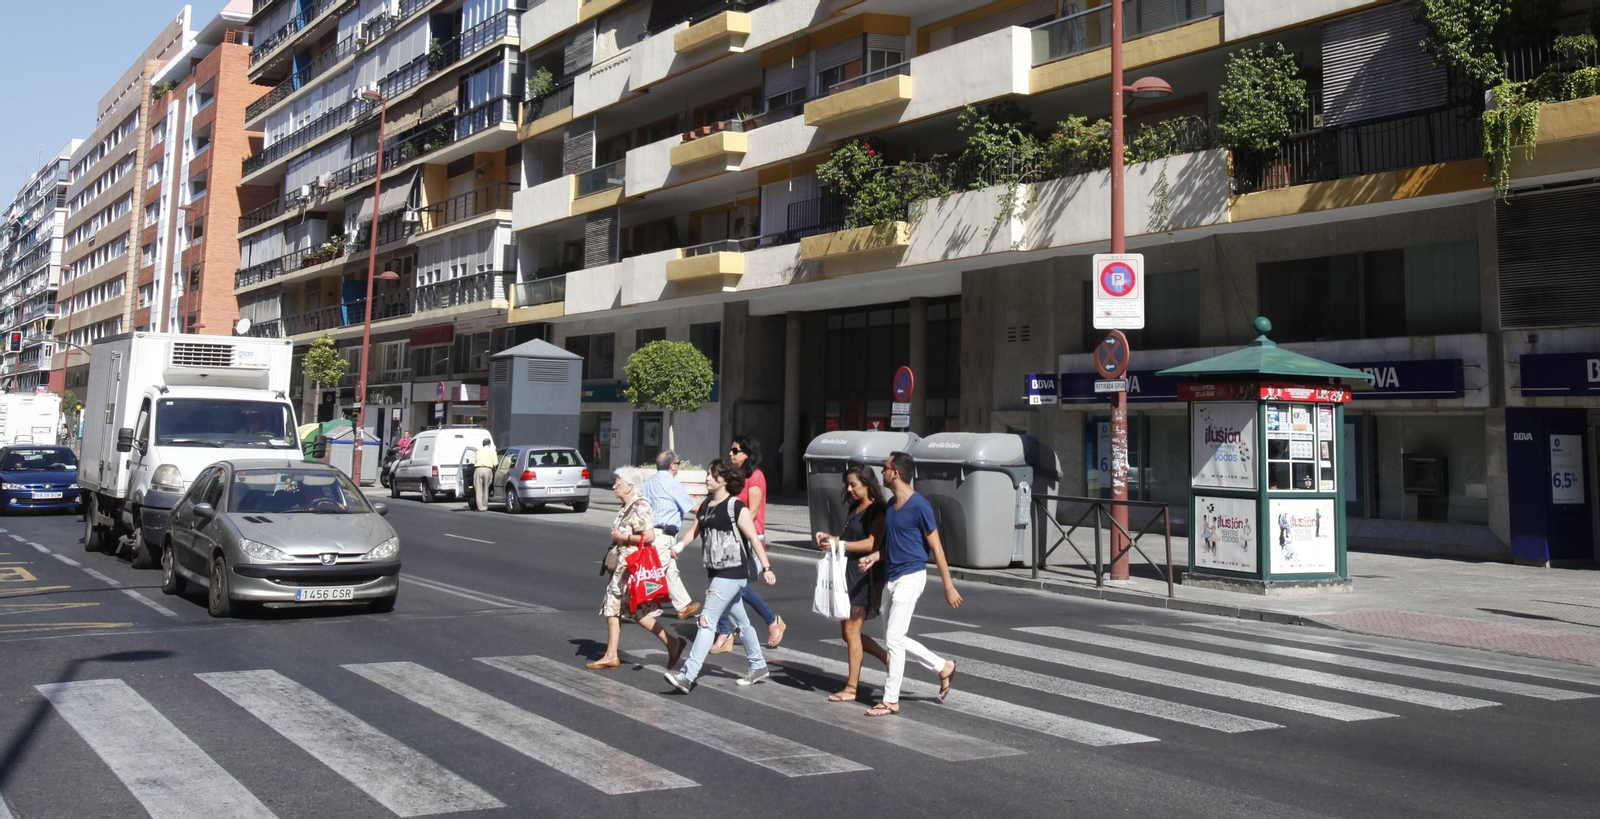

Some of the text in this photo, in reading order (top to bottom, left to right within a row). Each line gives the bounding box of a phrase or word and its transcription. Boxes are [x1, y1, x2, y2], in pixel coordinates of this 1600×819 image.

[1114, 274, 1122, 284] P
[1031, 379, 1055, 390] BBVA
[1204, 425, 1241, 444] ilusión
[1513, 432, 1533, 441] BBVA
[1213, 451, 1238, 462] todos
[1553, 472, 1572, 490] 6,5
[1217, 514, 1244, 529] ilusión
[1290, 514, 1318, 528] ilusión
[1222, 529, 1239, 537] ENTRE
[1221, 535, 1239, 543] TODOS
[304, 588, 351, 599] 1456 CSR
